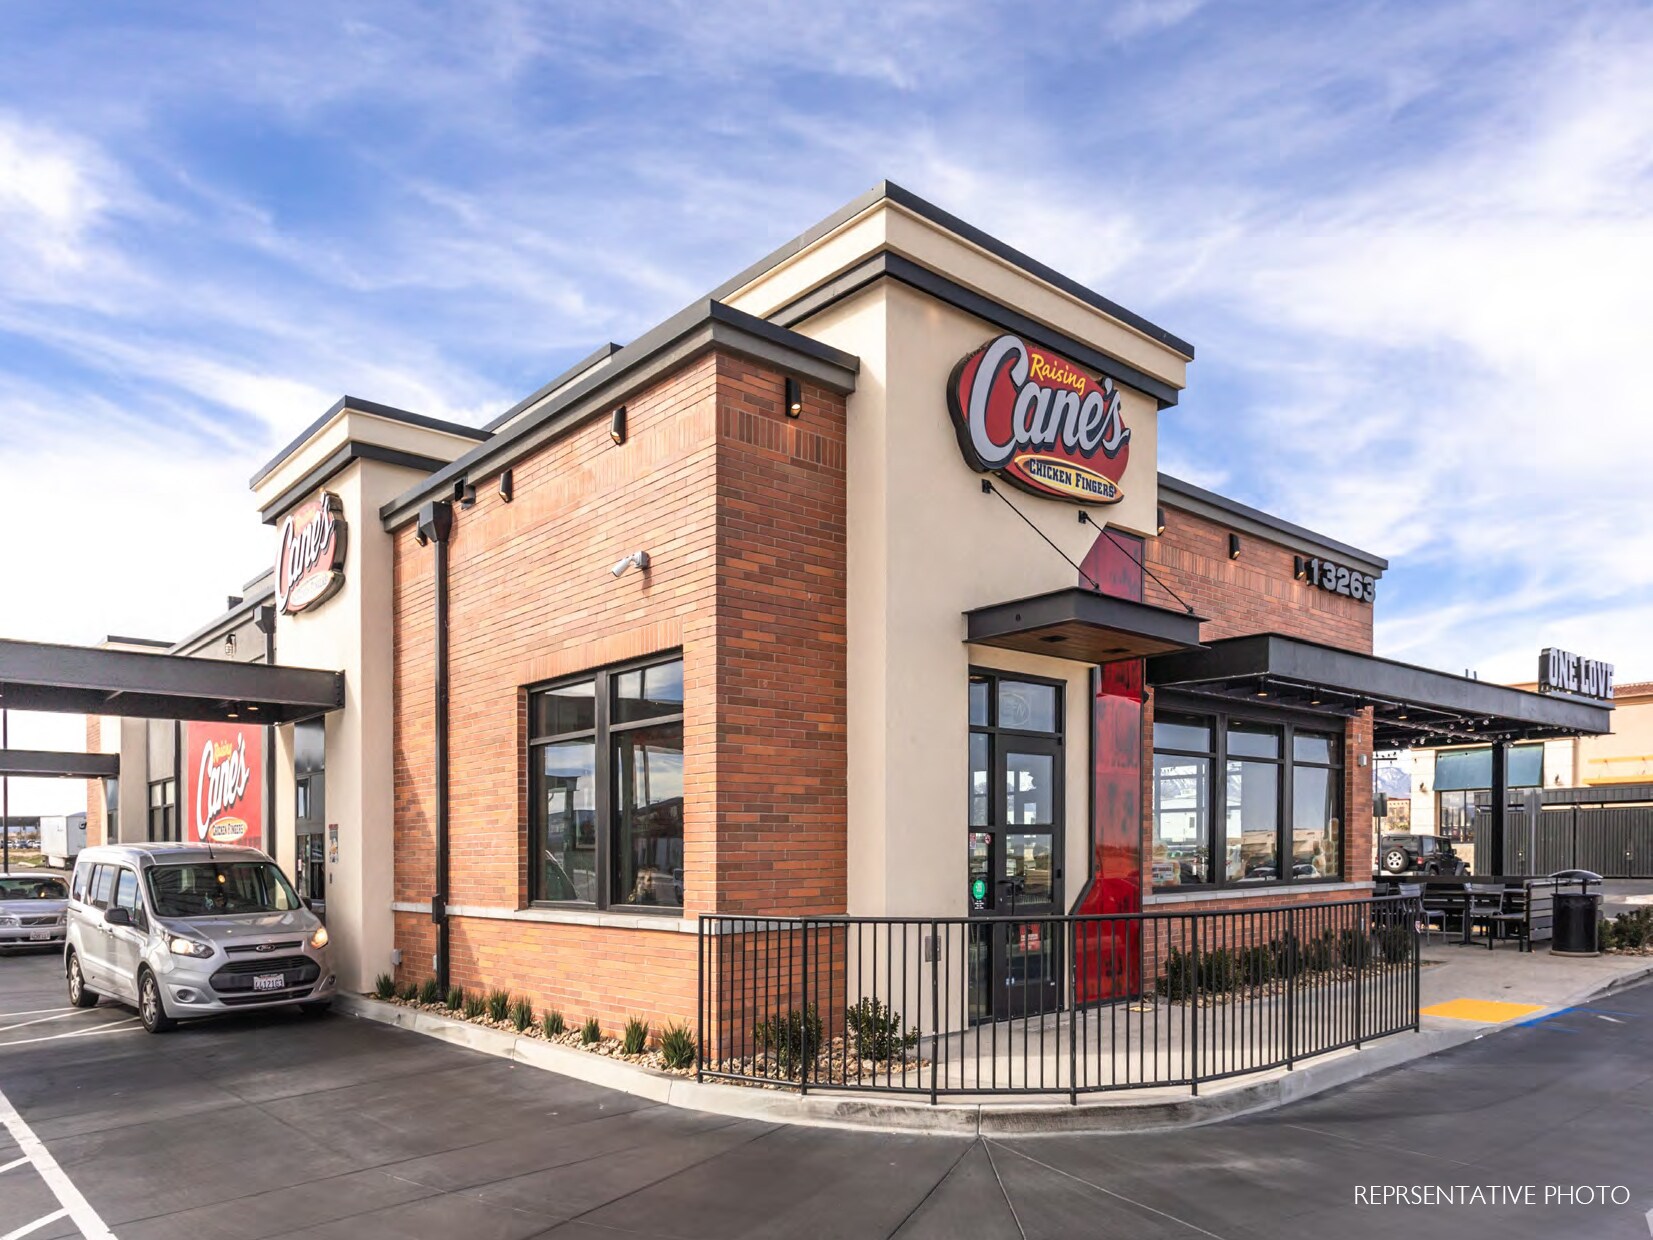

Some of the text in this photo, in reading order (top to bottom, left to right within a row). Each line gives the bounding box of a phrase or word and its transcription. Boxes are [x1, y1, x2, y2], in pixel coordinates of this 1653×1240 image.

[969, 335, 1131, 462] Cane's
[1030, 353, 1086, 396] Raising
[1029, 458, 1115, 498] CHICKEN FINGERS
[275, 491, 335, 613] Cane's
[1311, 558, 1376, 603] 13263
[1549, 647, 1614, 699] ONE LOVE
[196, 732, 250, 840] Cane's
